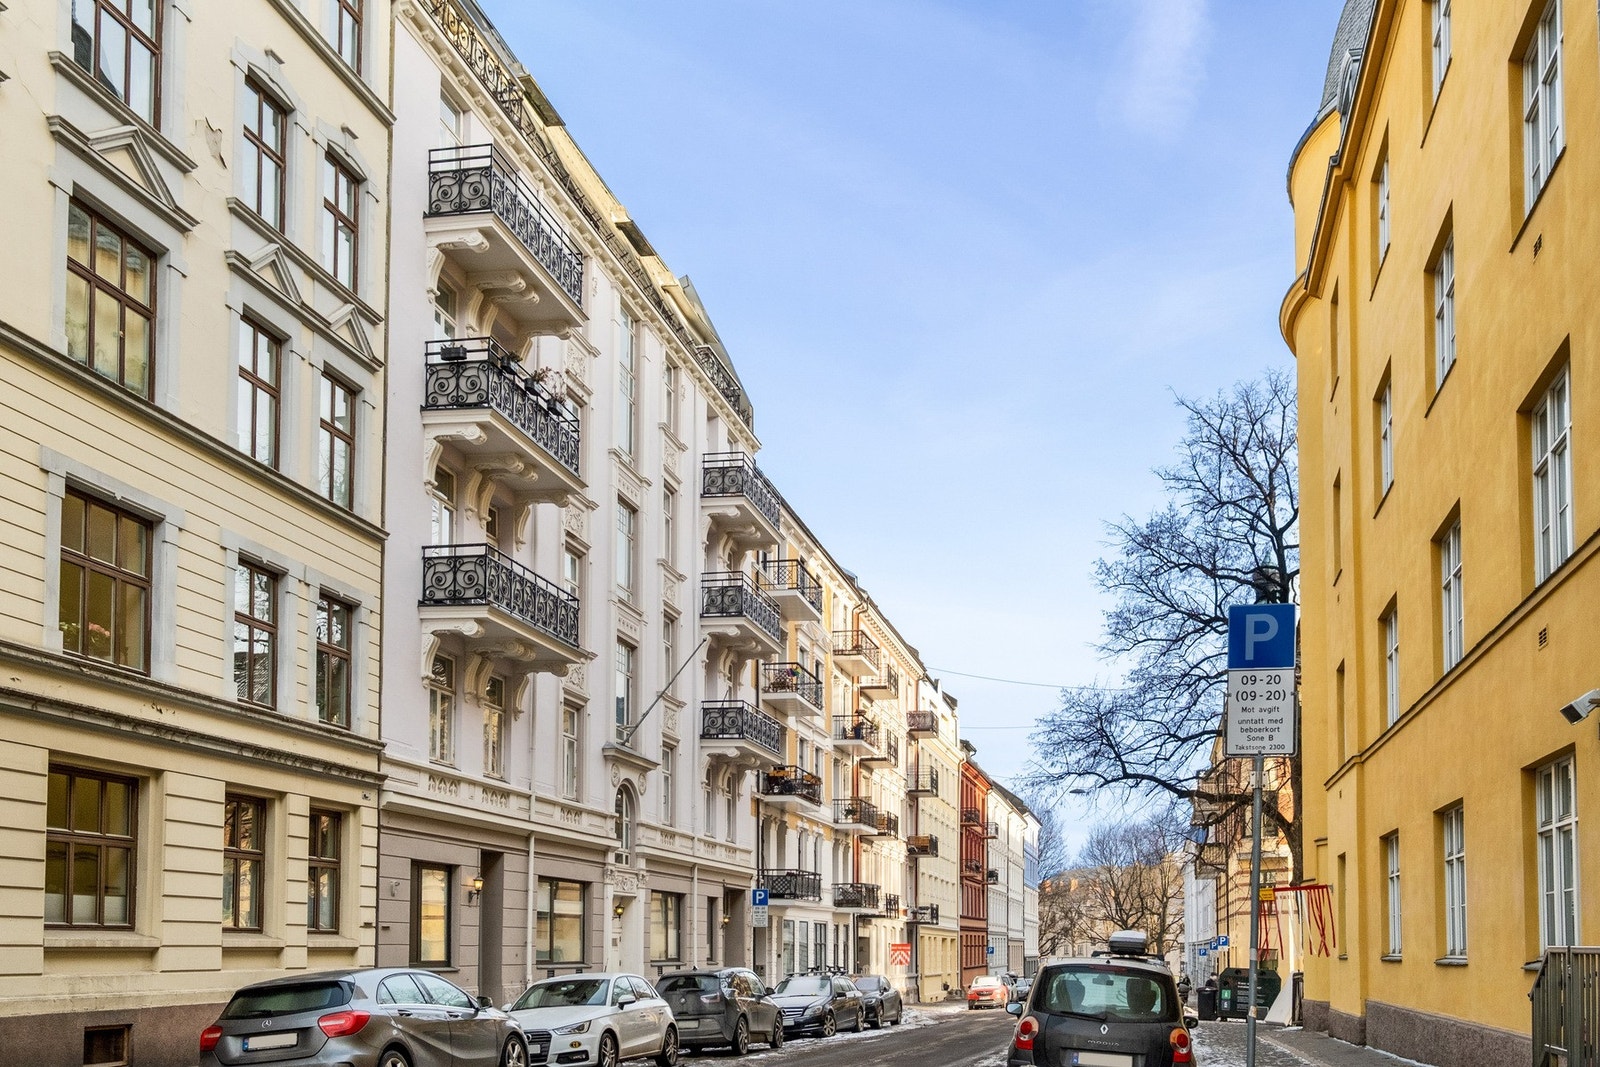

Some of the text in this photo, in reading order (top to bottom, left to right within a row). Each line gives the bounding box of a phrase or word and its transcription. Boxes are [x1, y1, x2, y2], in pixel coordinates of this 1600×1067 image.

[1245, 613, 1279, 661] P
[1258, 706, 1280, 714] avgift
[1246, 734, 1265, 742] Sone
[756, 891, 765, 904] P
[1220, 936, 1226, 945] P
